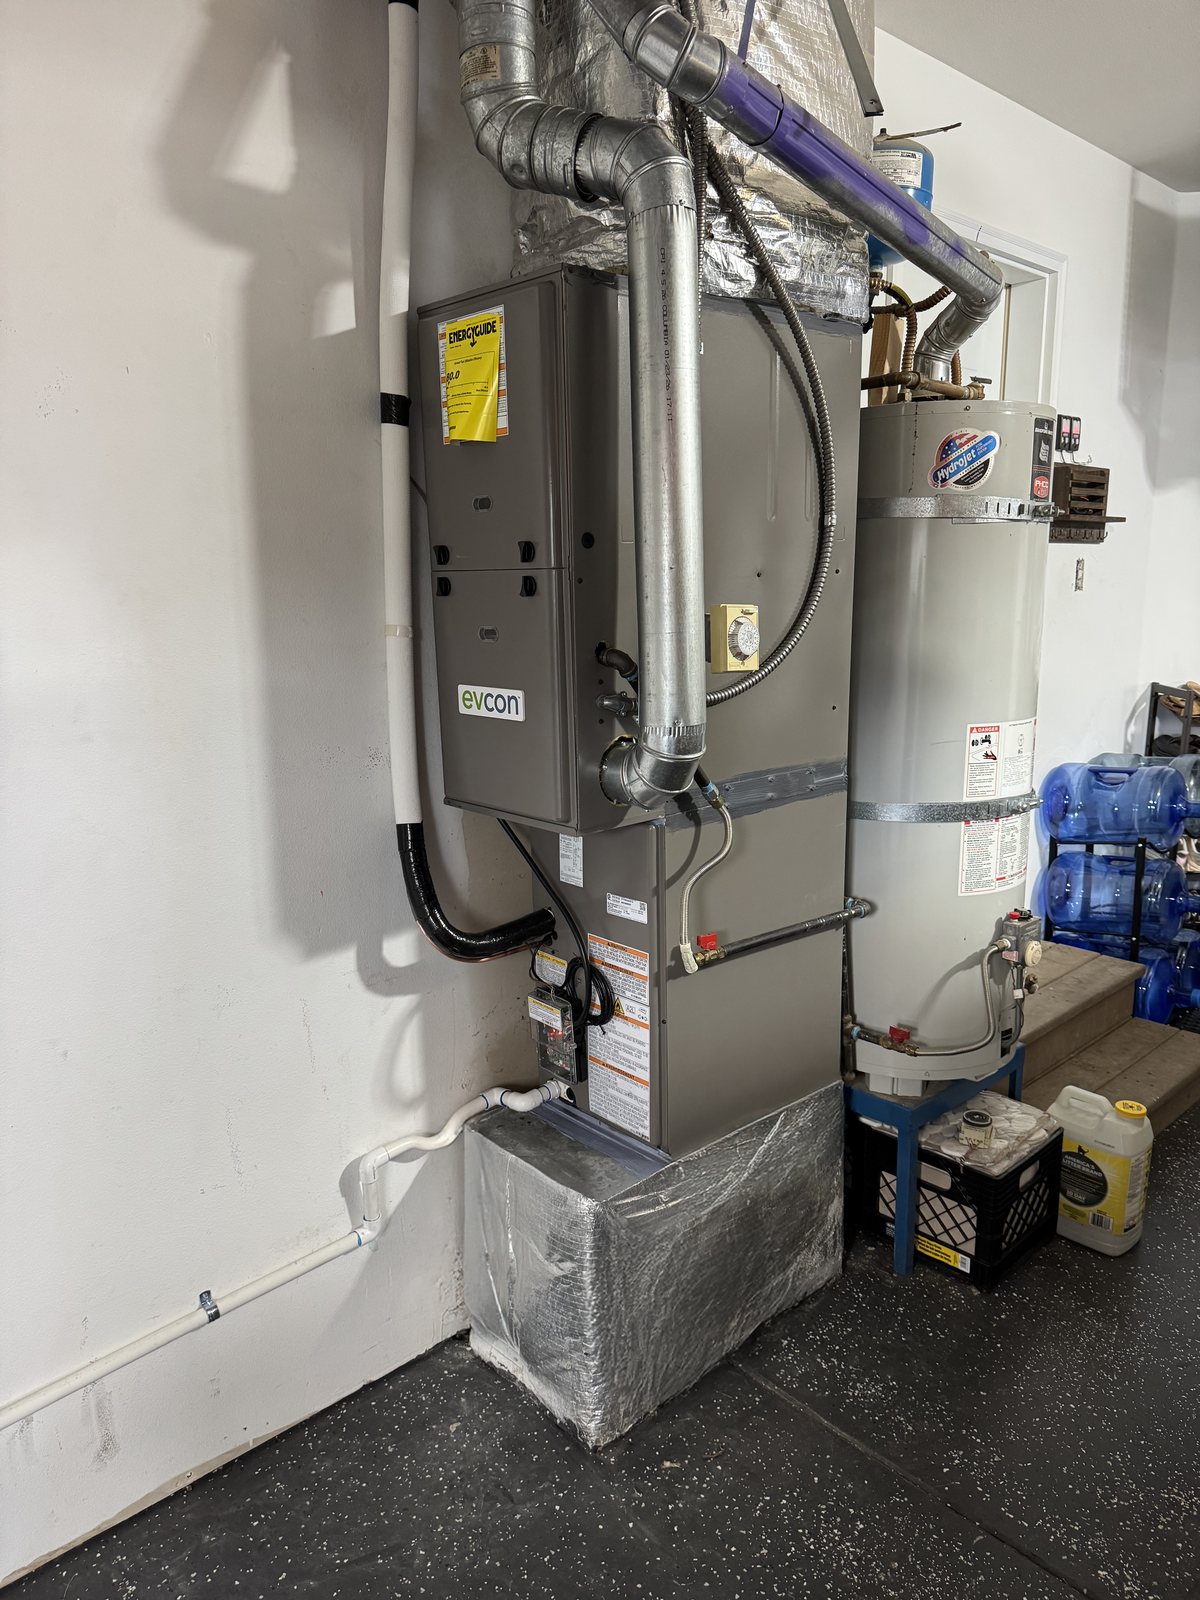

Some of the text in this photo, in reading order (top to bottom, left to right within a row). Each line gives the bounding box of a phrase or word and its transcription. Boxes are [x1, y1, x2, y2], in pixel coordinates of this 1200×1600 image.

[448, 320, 497, 346] ENERGYGUIDE
[936, 448, 977, 482] Hydrojet
[462, 689, 519, 716] evcon
[1062, 1157, 1103, 1177] LITTER BRAND
[1064, 1154, 1096, 1170] AMERICA'S
